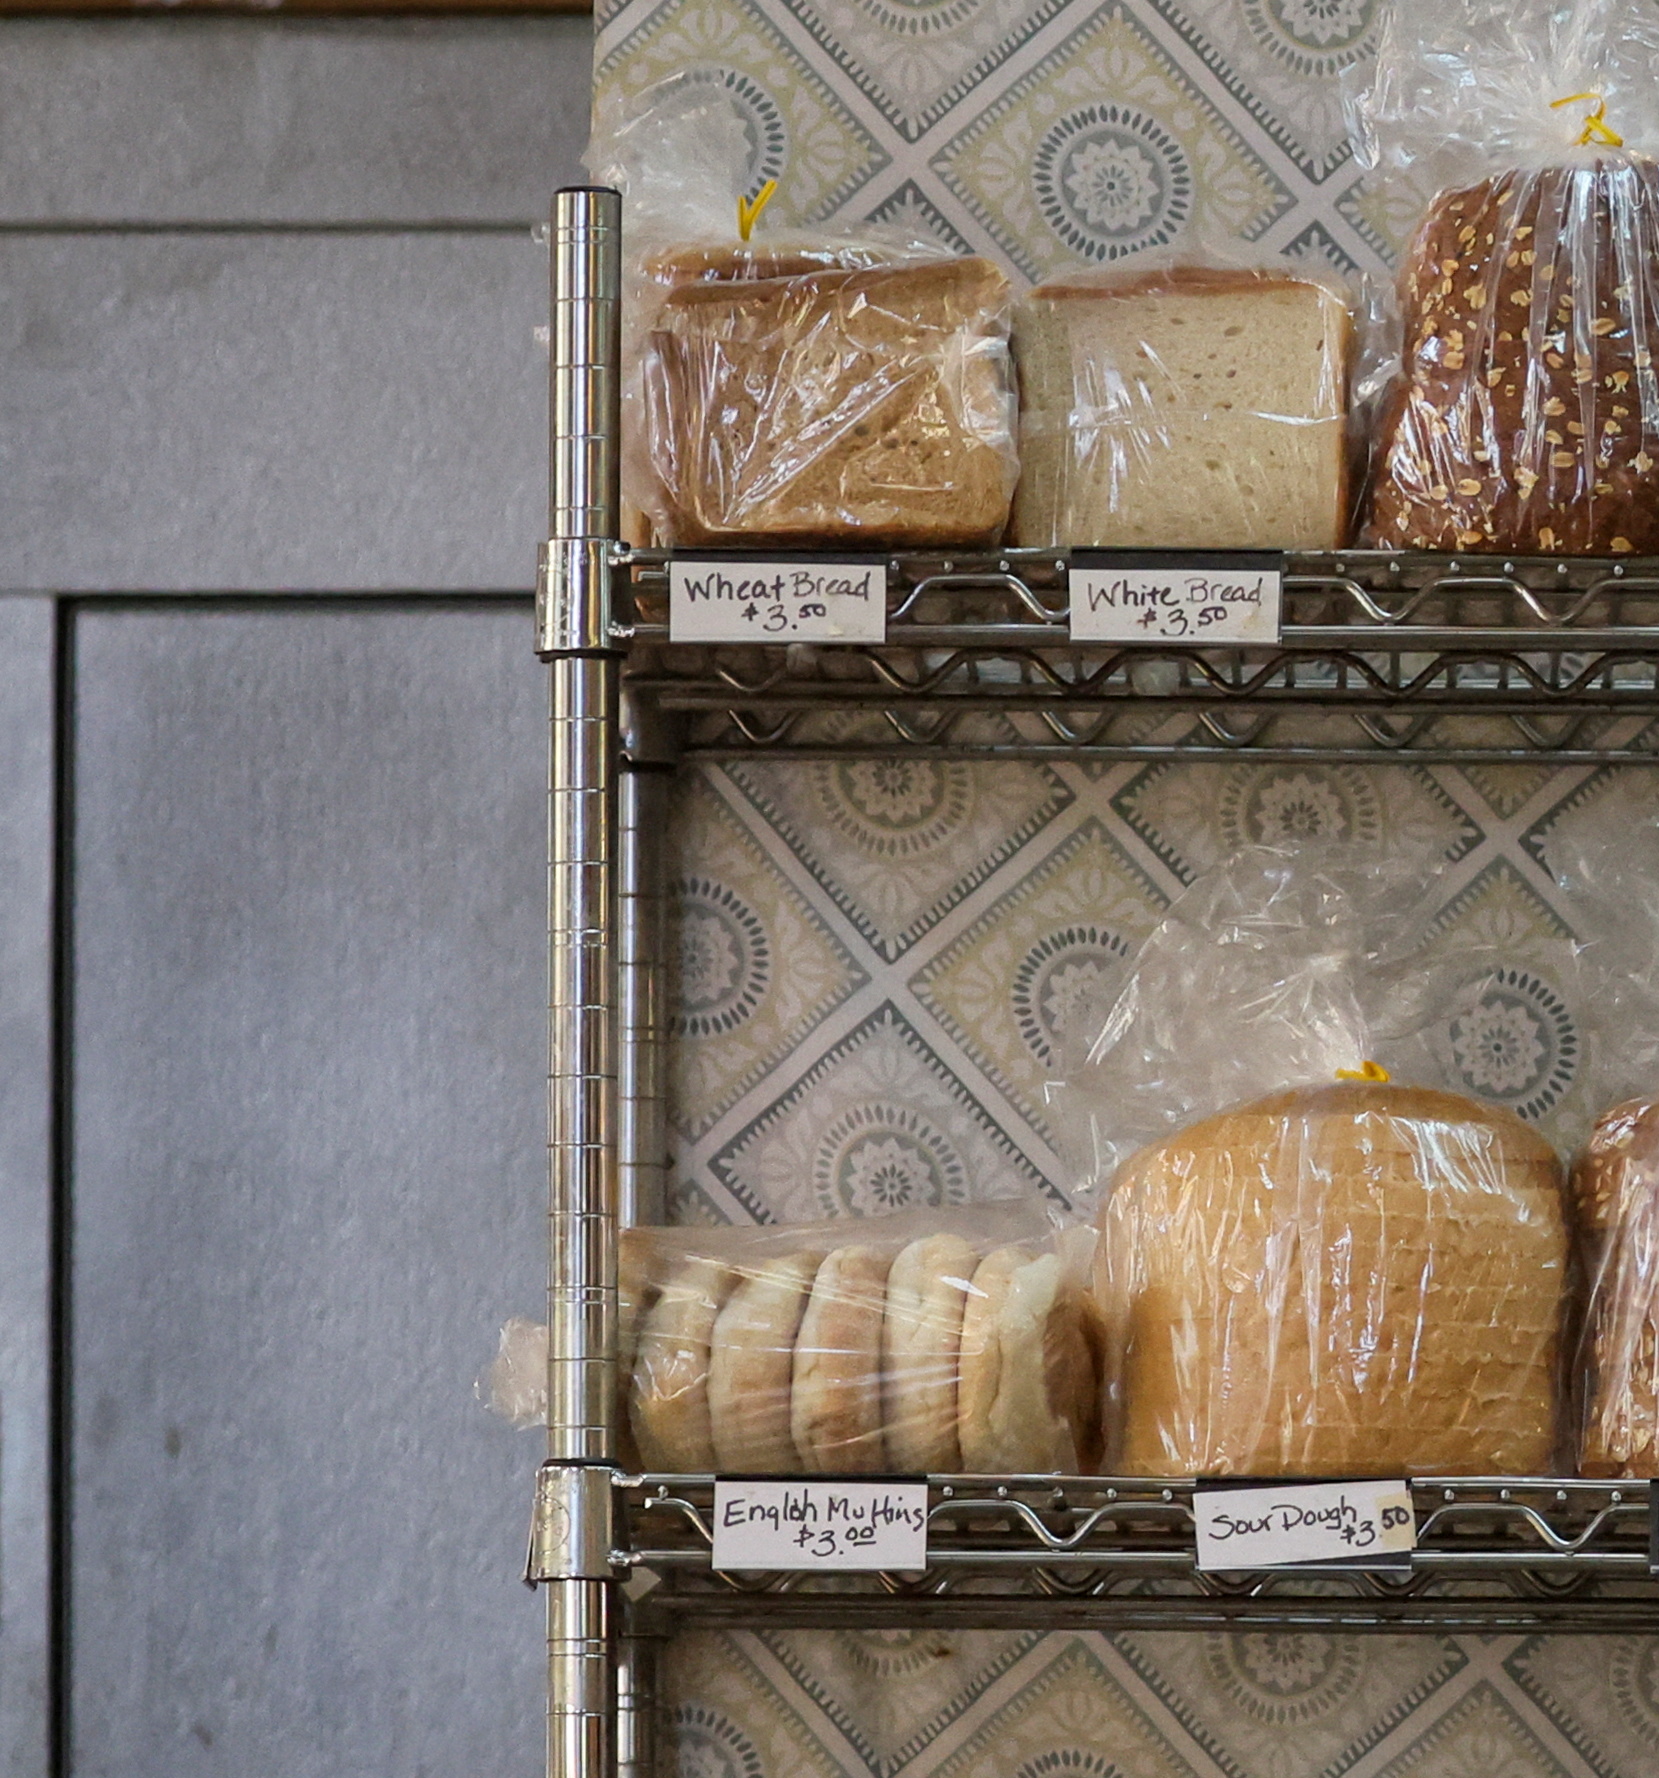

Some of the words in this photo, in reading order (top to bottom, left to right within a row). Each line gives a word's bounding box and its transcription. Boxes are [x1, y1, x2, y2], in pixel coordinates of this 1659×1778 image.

[684, 572, 785, 602] Wheat
[789, 571, 871, 601] Bread
[1087, 579, 1180, 612] White
[1184, 577, 1264, 607] Bread
[1208, 1513, 1274, 1540] Sour
[1270, 1494, 1358, 1531] Dough
